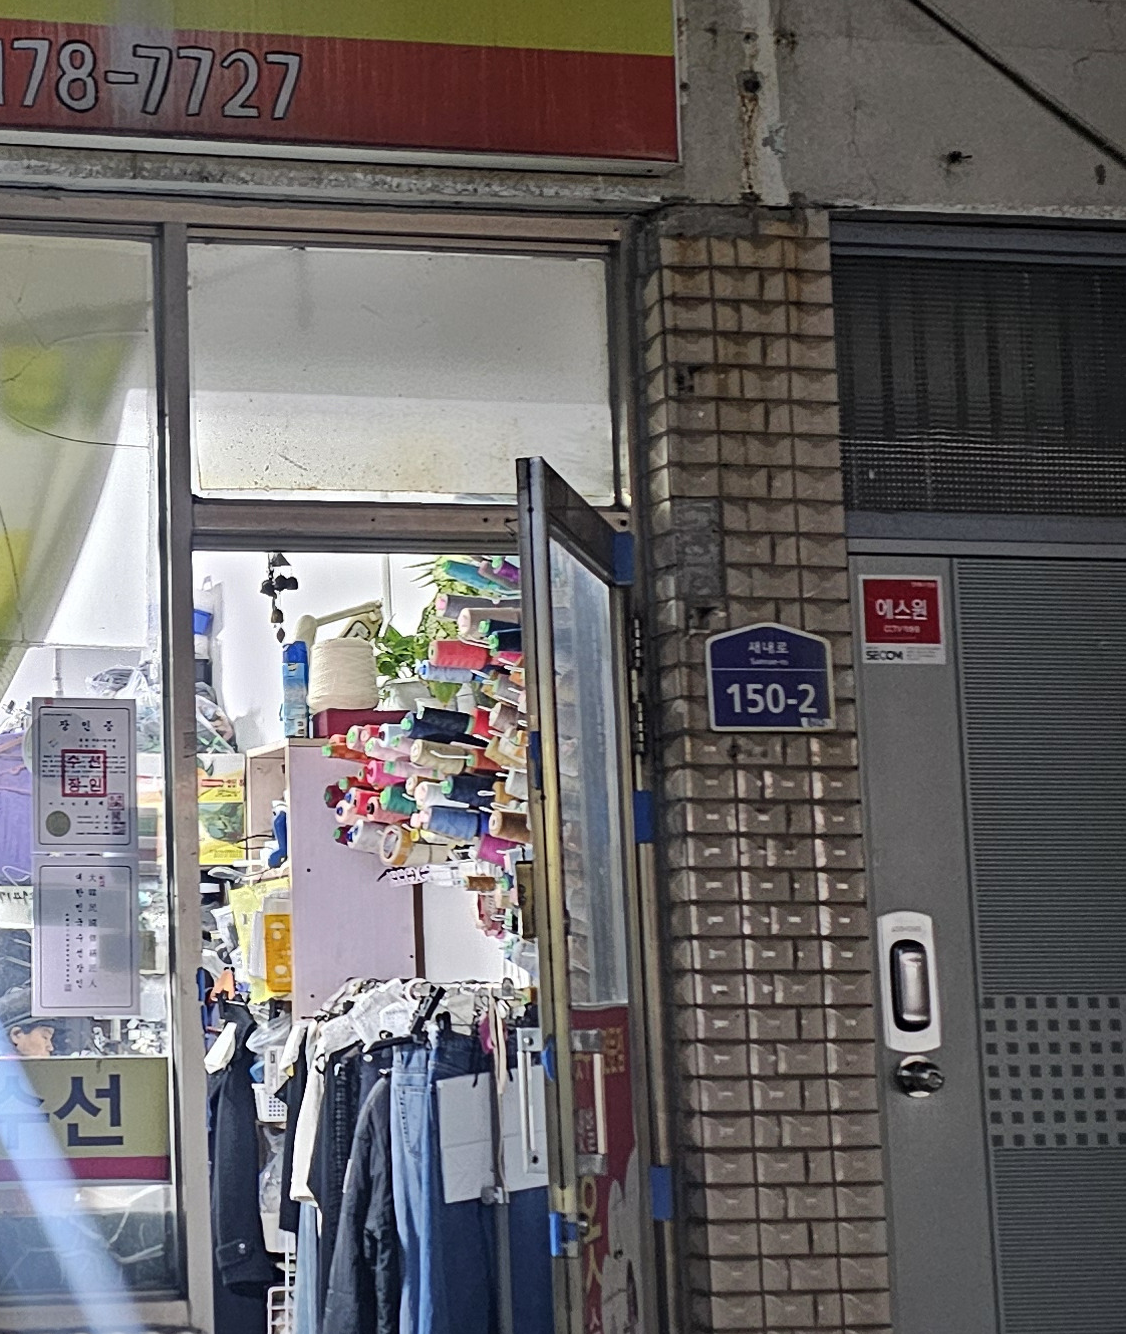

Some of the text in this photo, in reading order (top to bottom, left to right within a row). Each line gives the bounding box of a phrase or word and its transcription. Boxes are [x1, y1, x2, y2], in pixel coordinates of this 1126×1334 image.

[875, 598, 928, 621] 에스원
[865, 650, 904, 661] SECOM
[726, 683, 819, 714] 150-2
